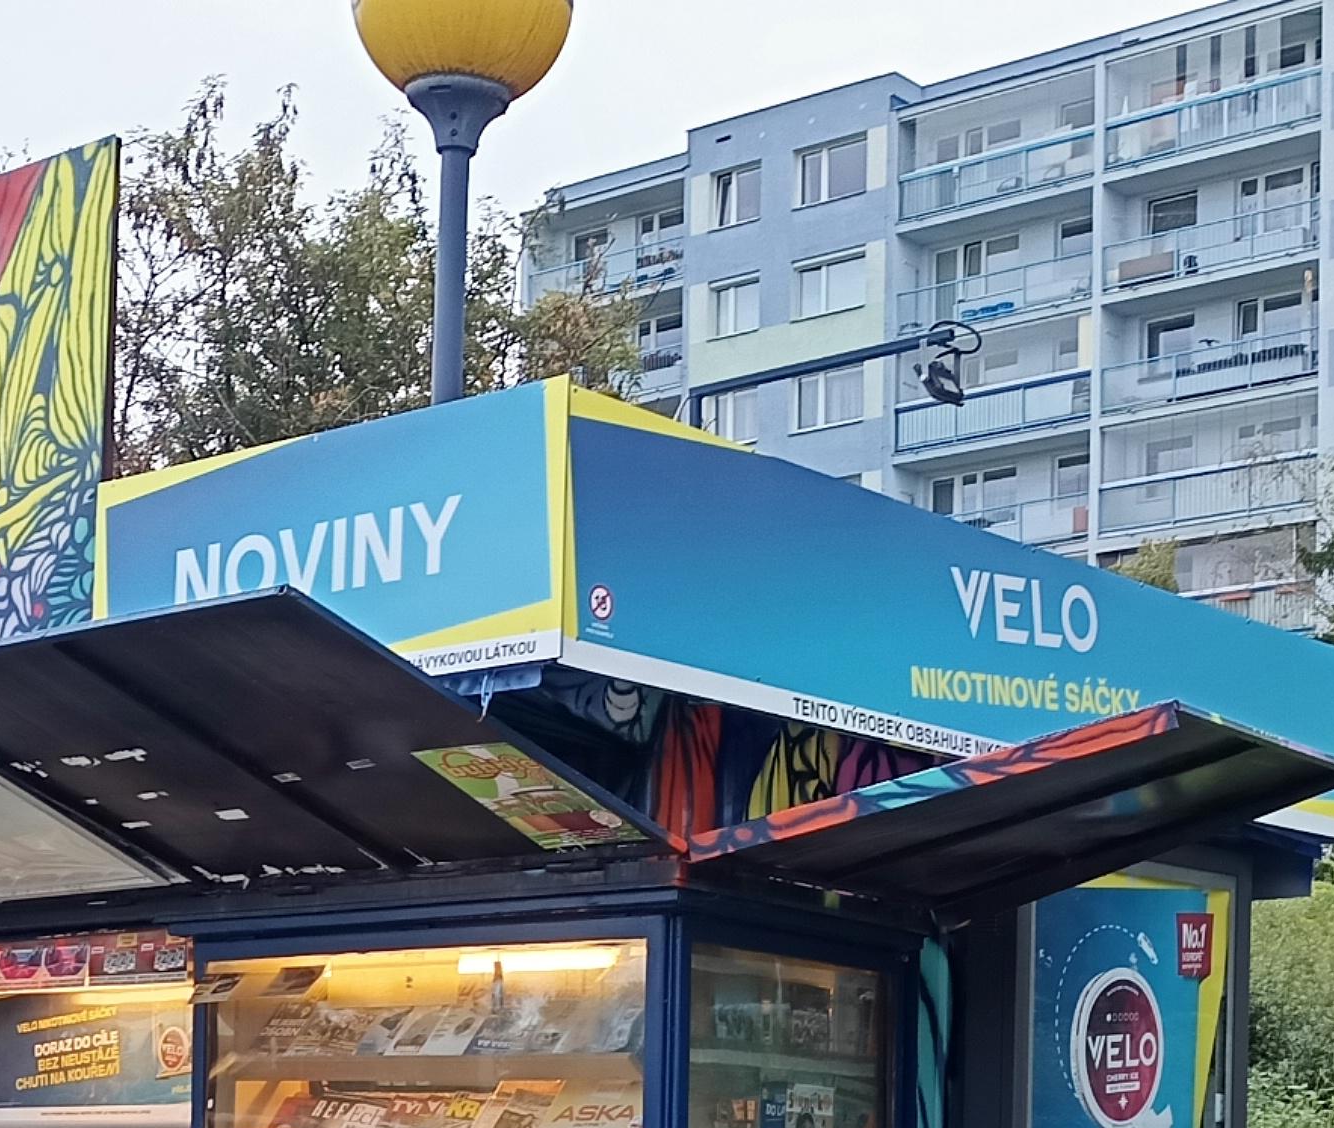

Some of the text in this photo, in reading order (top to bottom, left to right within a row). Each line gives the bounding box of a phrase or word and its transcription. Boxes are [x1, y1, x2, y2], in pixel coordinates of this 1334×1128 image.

[174, 494, 463, 606] NOVINY
[950, 566, 1099, 653] VELO
[485, 640, 537, 660] LÁTKOU
[910, 665, 1141, 716] NIKOTINOVÉ SÁČKY
[793, 697, 838, 723] TENTO
[841, 706, 903, 739] VÝROBEK
[906, 724, 972, 754] OBSAHUJE
[34, 1029, 119, 1058] DORAZ DO CÍLE
[1088, 1032, 1157, 1071] VELO
[15, 1073, 48, 1091] CHUTI
[50, 1070, 66, 1086] NA
[37, 1055, 60, 1072] BEZ
